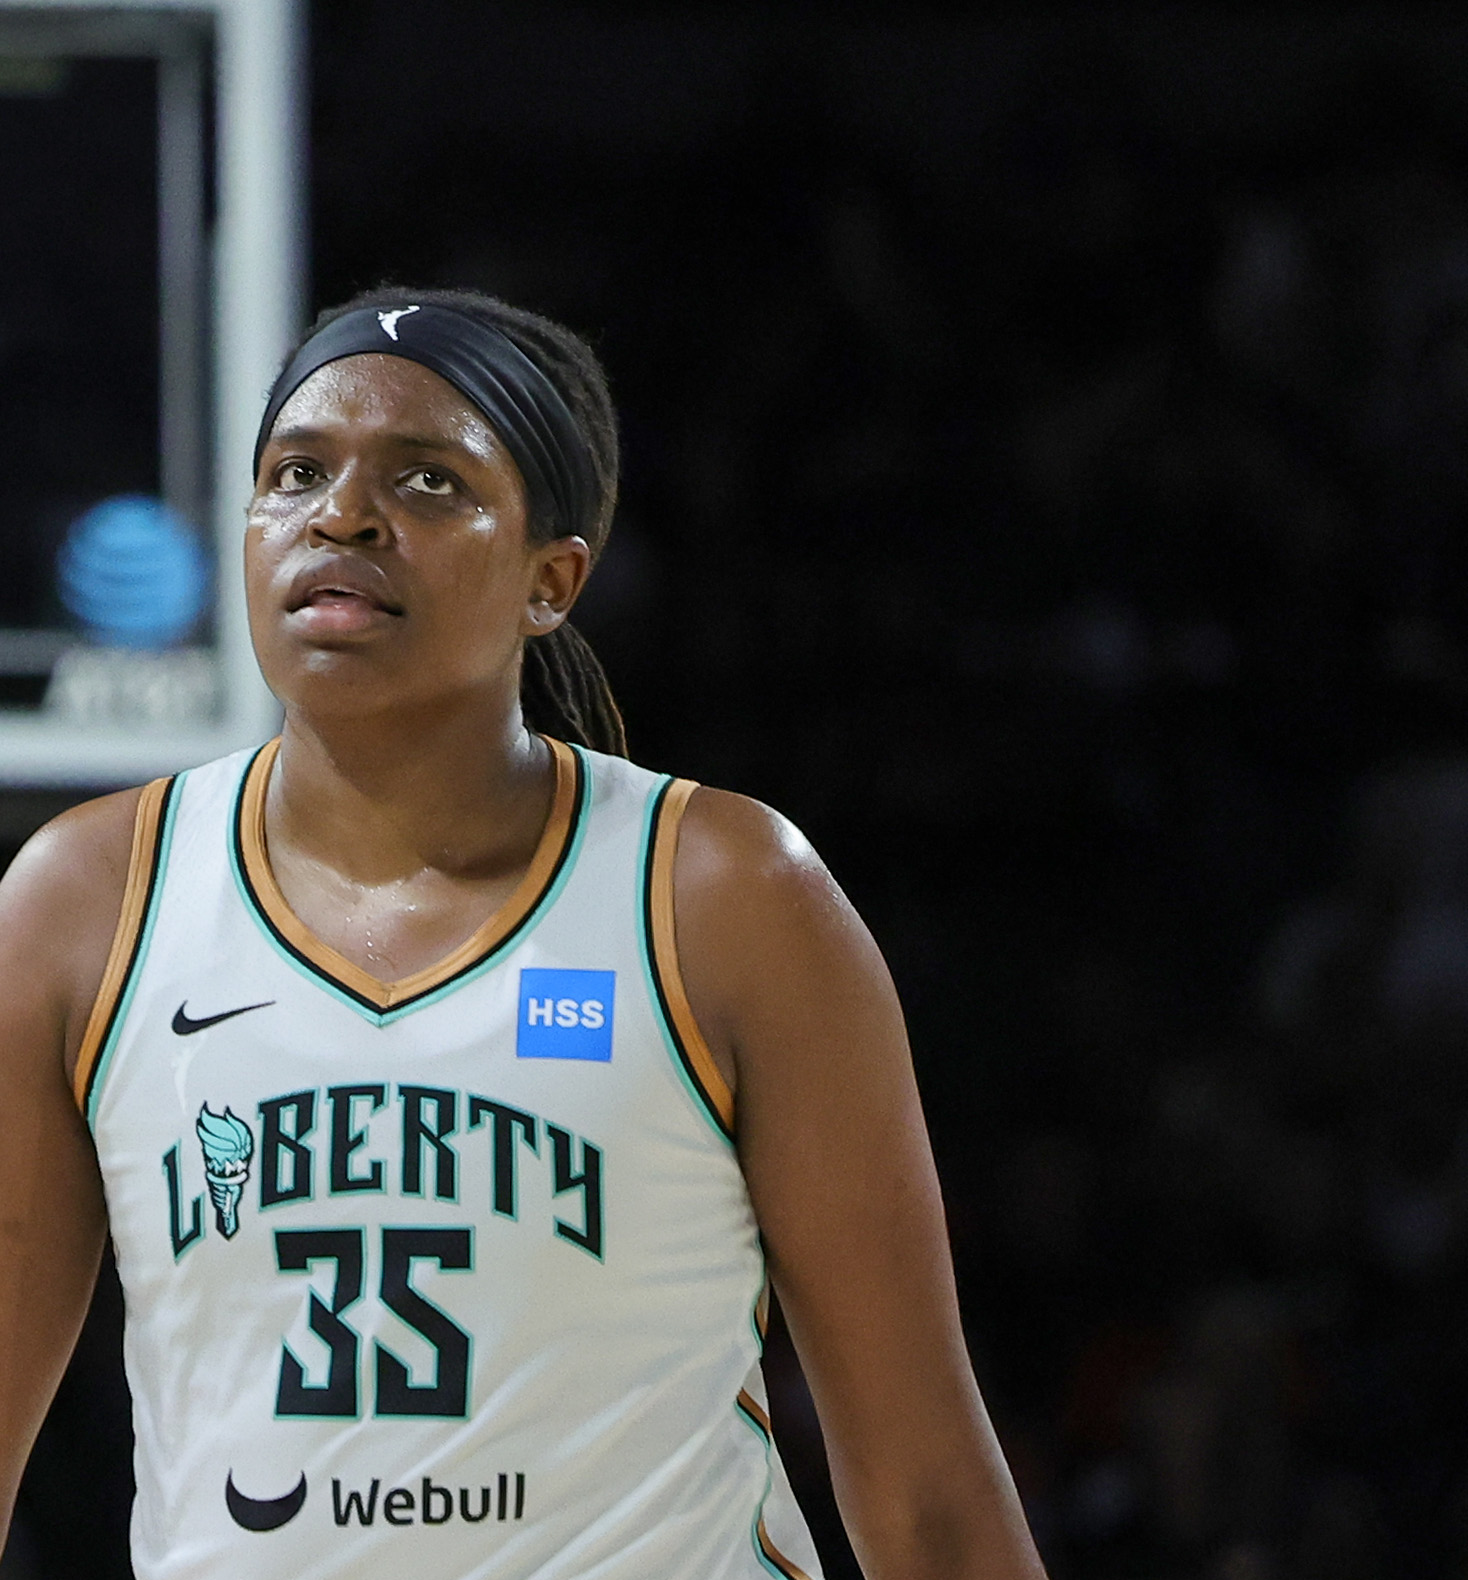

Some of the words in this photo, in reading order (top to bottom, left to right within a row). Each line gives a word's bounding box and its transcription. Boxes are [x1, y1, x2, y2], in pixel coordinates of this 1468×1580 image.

[527, 996, 605, 1030] HSS
[272, 1225, 475, 1421] 35
[331, 1472, 527, 1527] Webull
